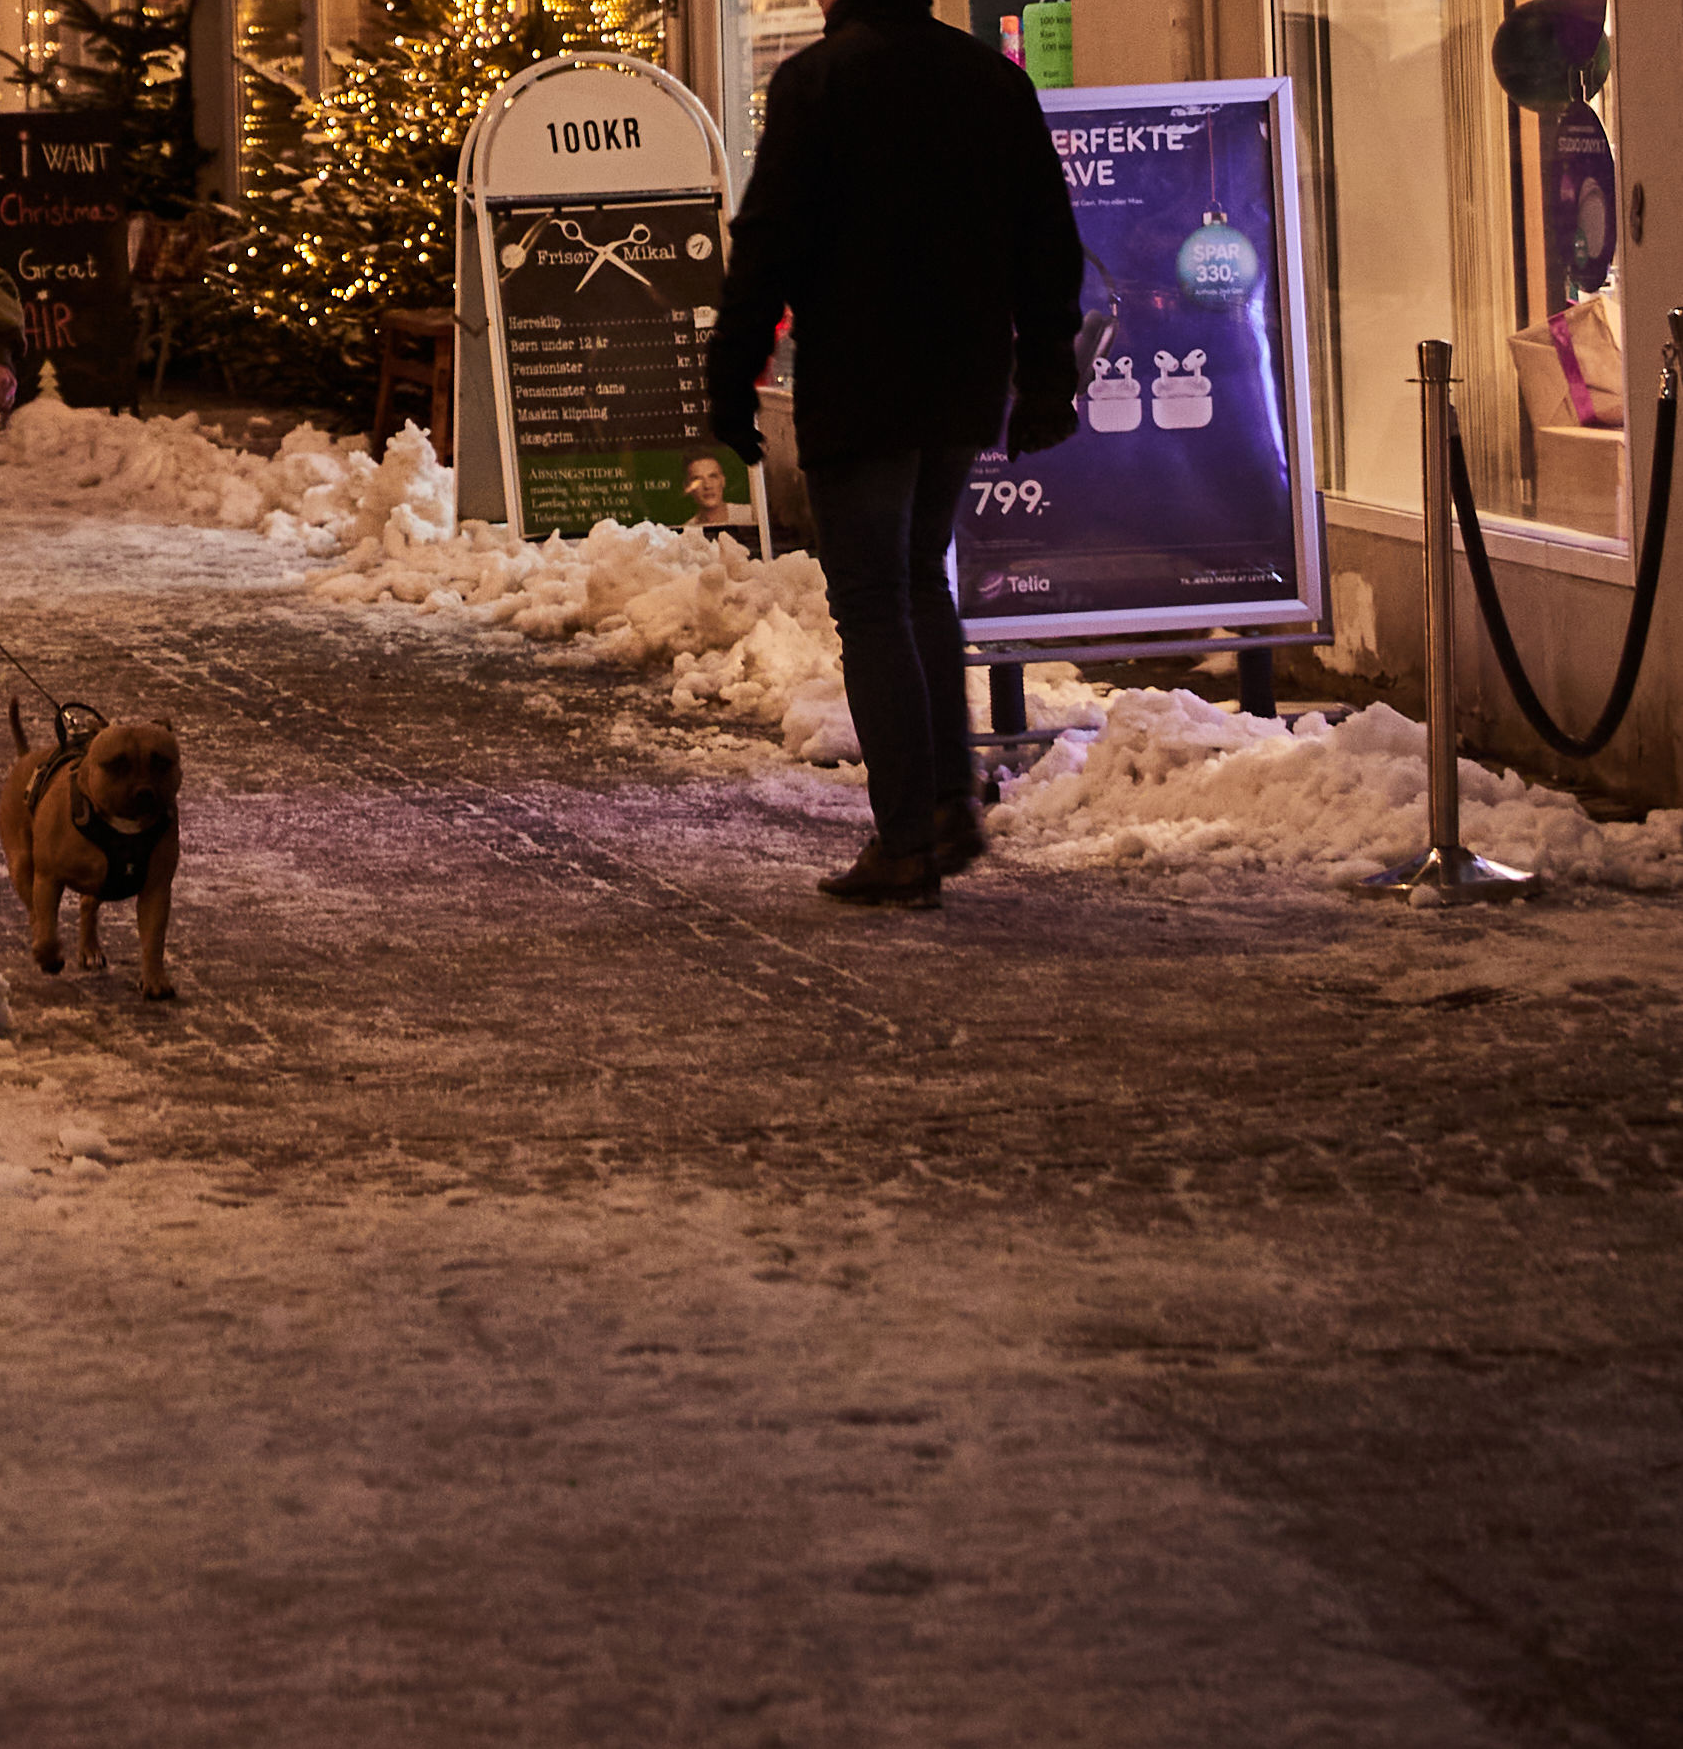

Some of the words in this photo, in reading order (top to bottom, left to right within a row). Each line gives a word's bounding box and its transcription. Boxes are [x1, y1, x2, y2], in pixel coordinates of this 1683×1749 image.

[546, 117, 641, 154] 100KR
[1051, 125, 1185, 155] ERFEKTE
[40, 142, 113, 174] WANT
[1061, 159, 1116, 187] AVE
[0, 192, 118, 226] Christmas
[536, 249, 594, 266] Frisør
[622, 244, 678, 262] Mikal
[1194, 243, 1240, 263] SPAR
[18, 248, 98, 281] Great
[1196, 264, 1240, 283] 330,-
[23, 302, 78, 350] AIR
[508, 315, 562, 331] Herreklip
[511, 339, 539, 353] Børn
[541, 337, 575, 352] under
[578, 337, 592, 350] 12
[595, 335, 609, 349] år
[512, 361, 583, 377] Pensionister
[515, 383, 586, 399] Pensionister
[595, 382, 626, 396] dame
[518, 407, 559, 423] Maskin
[561, 405, 609, 422] klipning
[519, 431, 574, 448] skægtrim
[969, 479, 1051, 516] 799,-
[1006, 575, 1051, 593] Telia
